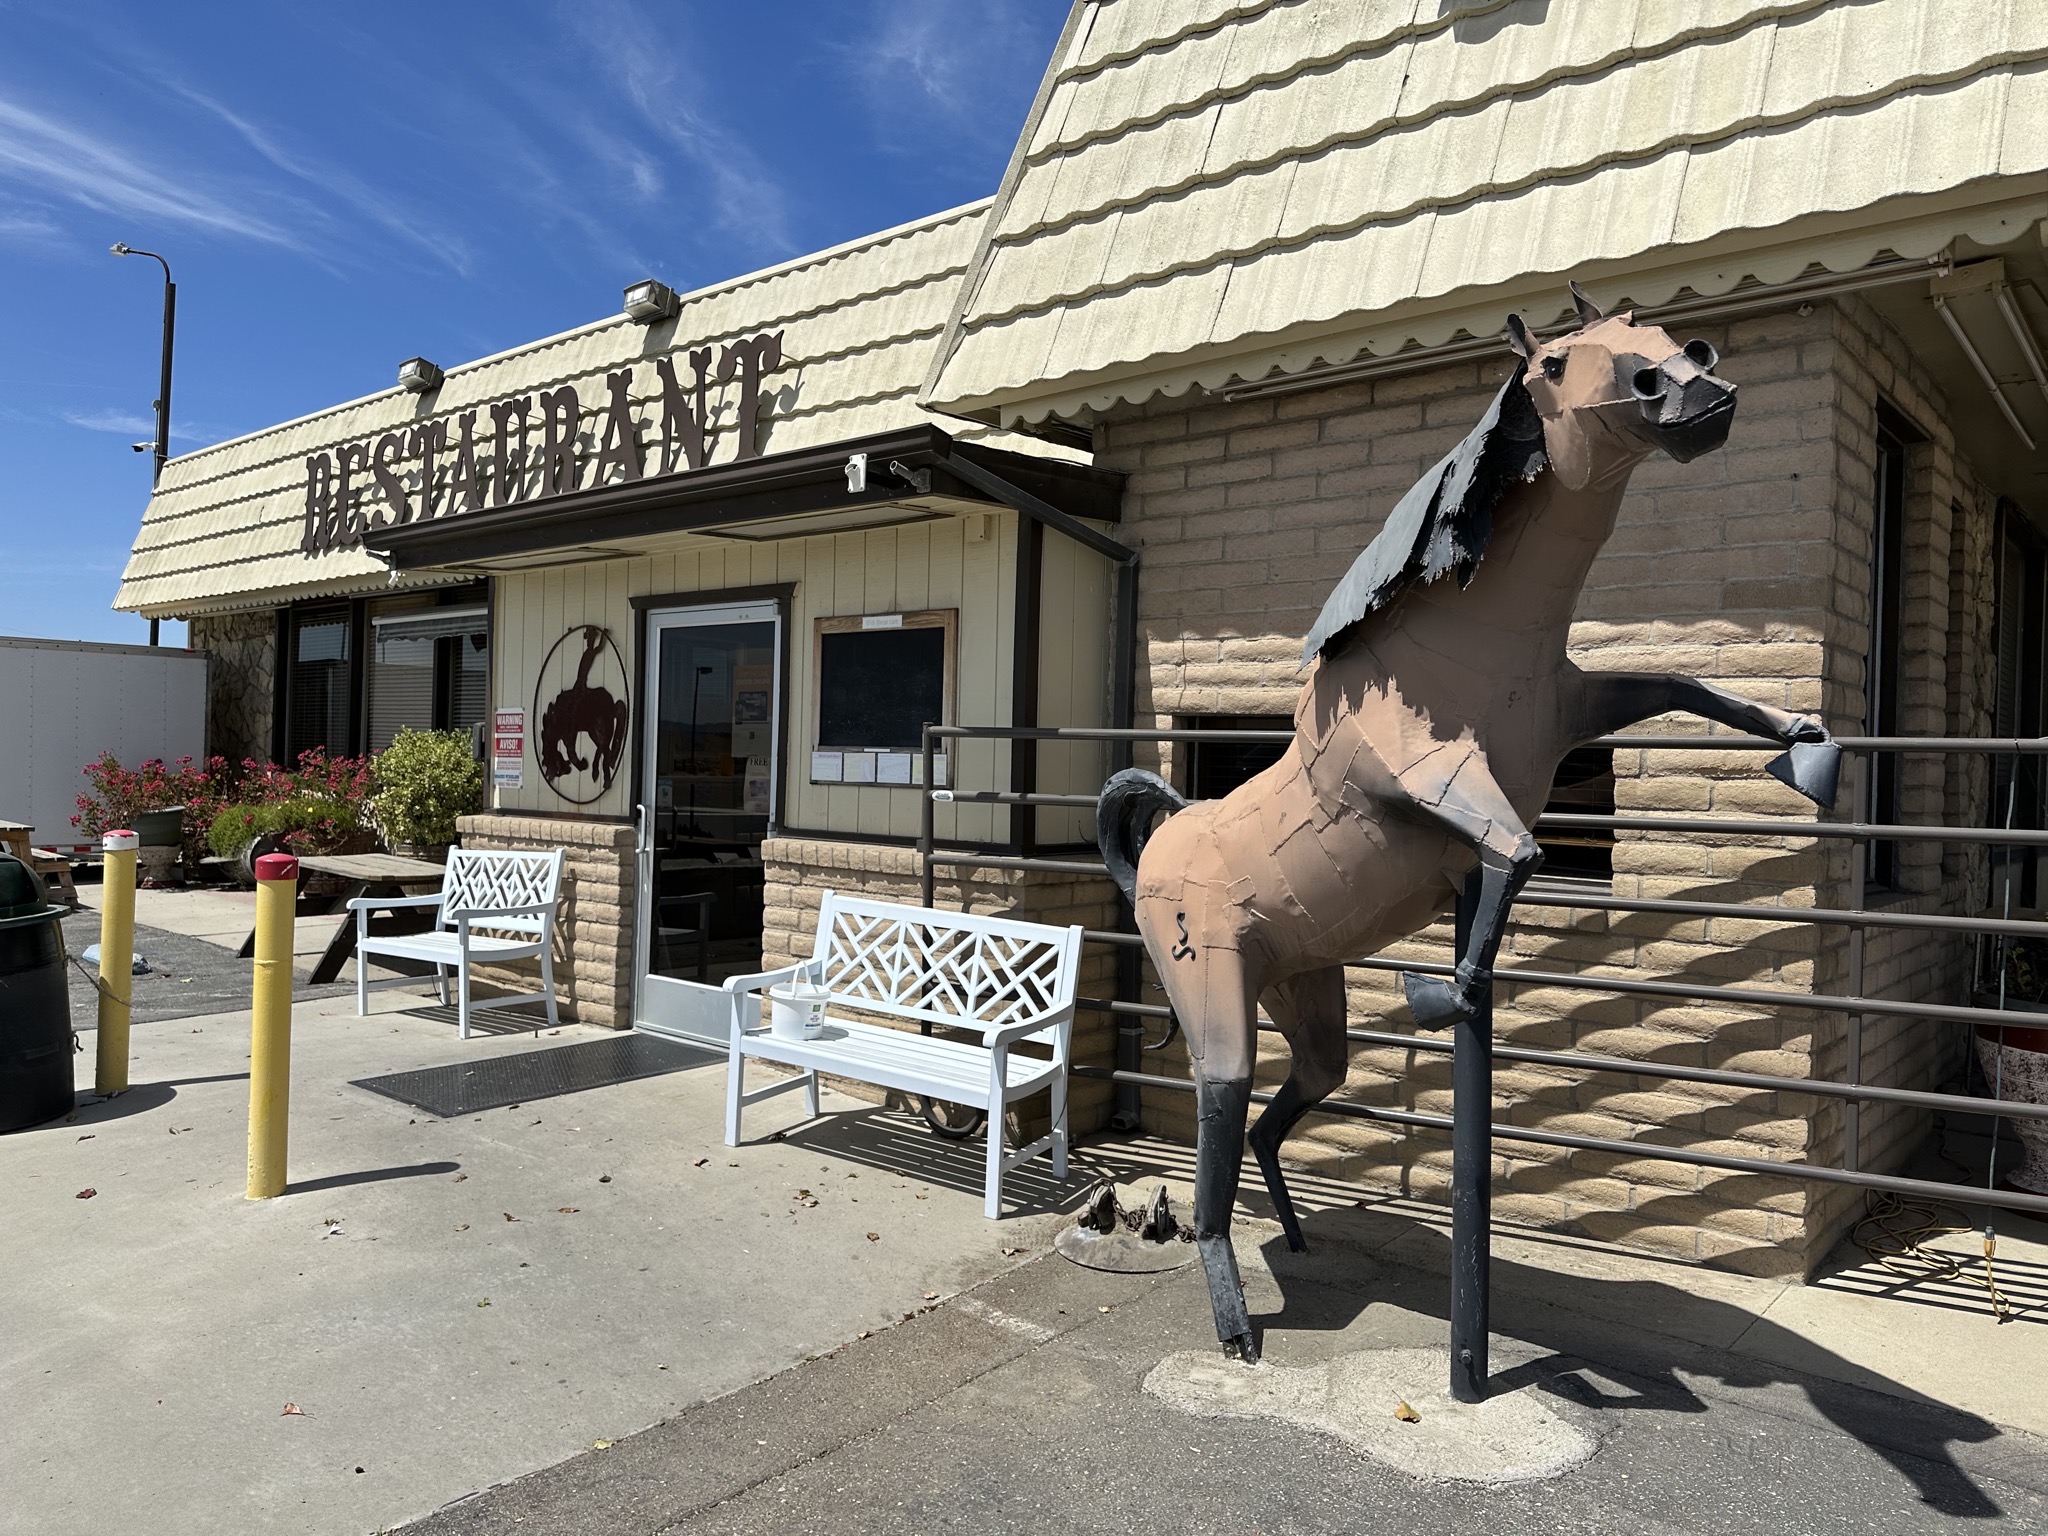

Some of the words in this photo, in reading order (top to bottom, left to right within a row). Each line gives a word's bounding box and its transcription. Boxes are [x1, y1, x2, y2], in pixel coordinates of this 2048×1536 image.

[300, 329, 784, 551] RESTAURANT
[497, 715, 523, 725] WARNING
[500, 739, 518, 750] AVISO!
[750, 757, 768, 766] FREE
